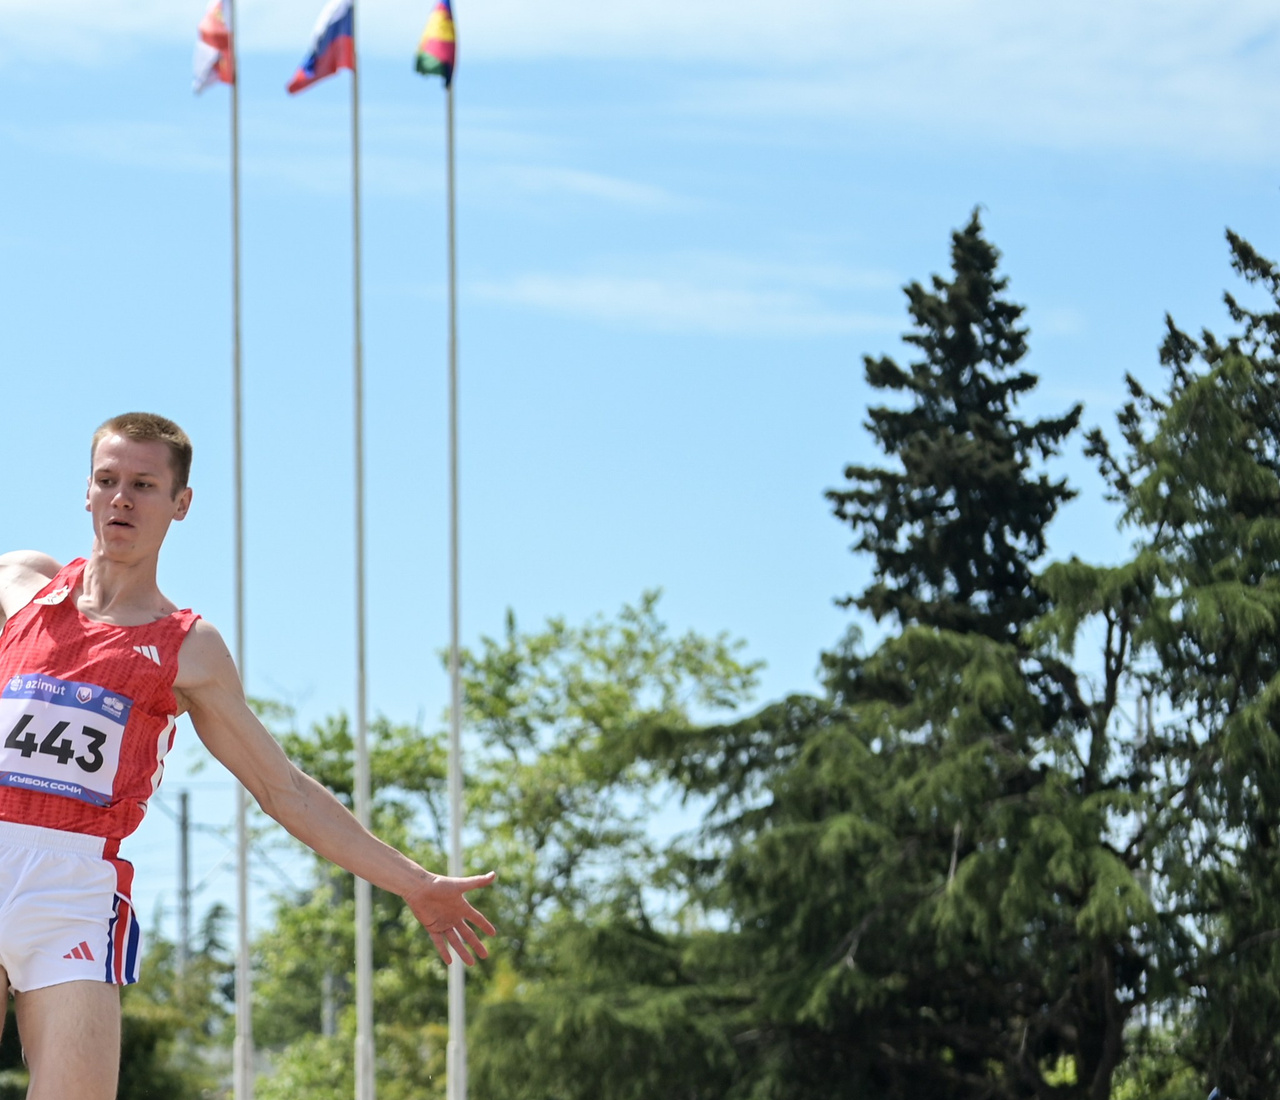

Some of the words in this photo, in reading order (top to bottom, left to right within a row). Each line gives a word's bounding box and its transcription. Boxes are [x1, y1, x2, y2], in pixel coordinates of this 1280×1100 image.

[25, 678, 66, 696] azimut
[4, 714, 107, 773] 443
[8, 774, 49, 788] КУБОК
[50, 782, 82, 795] СОЧИ
